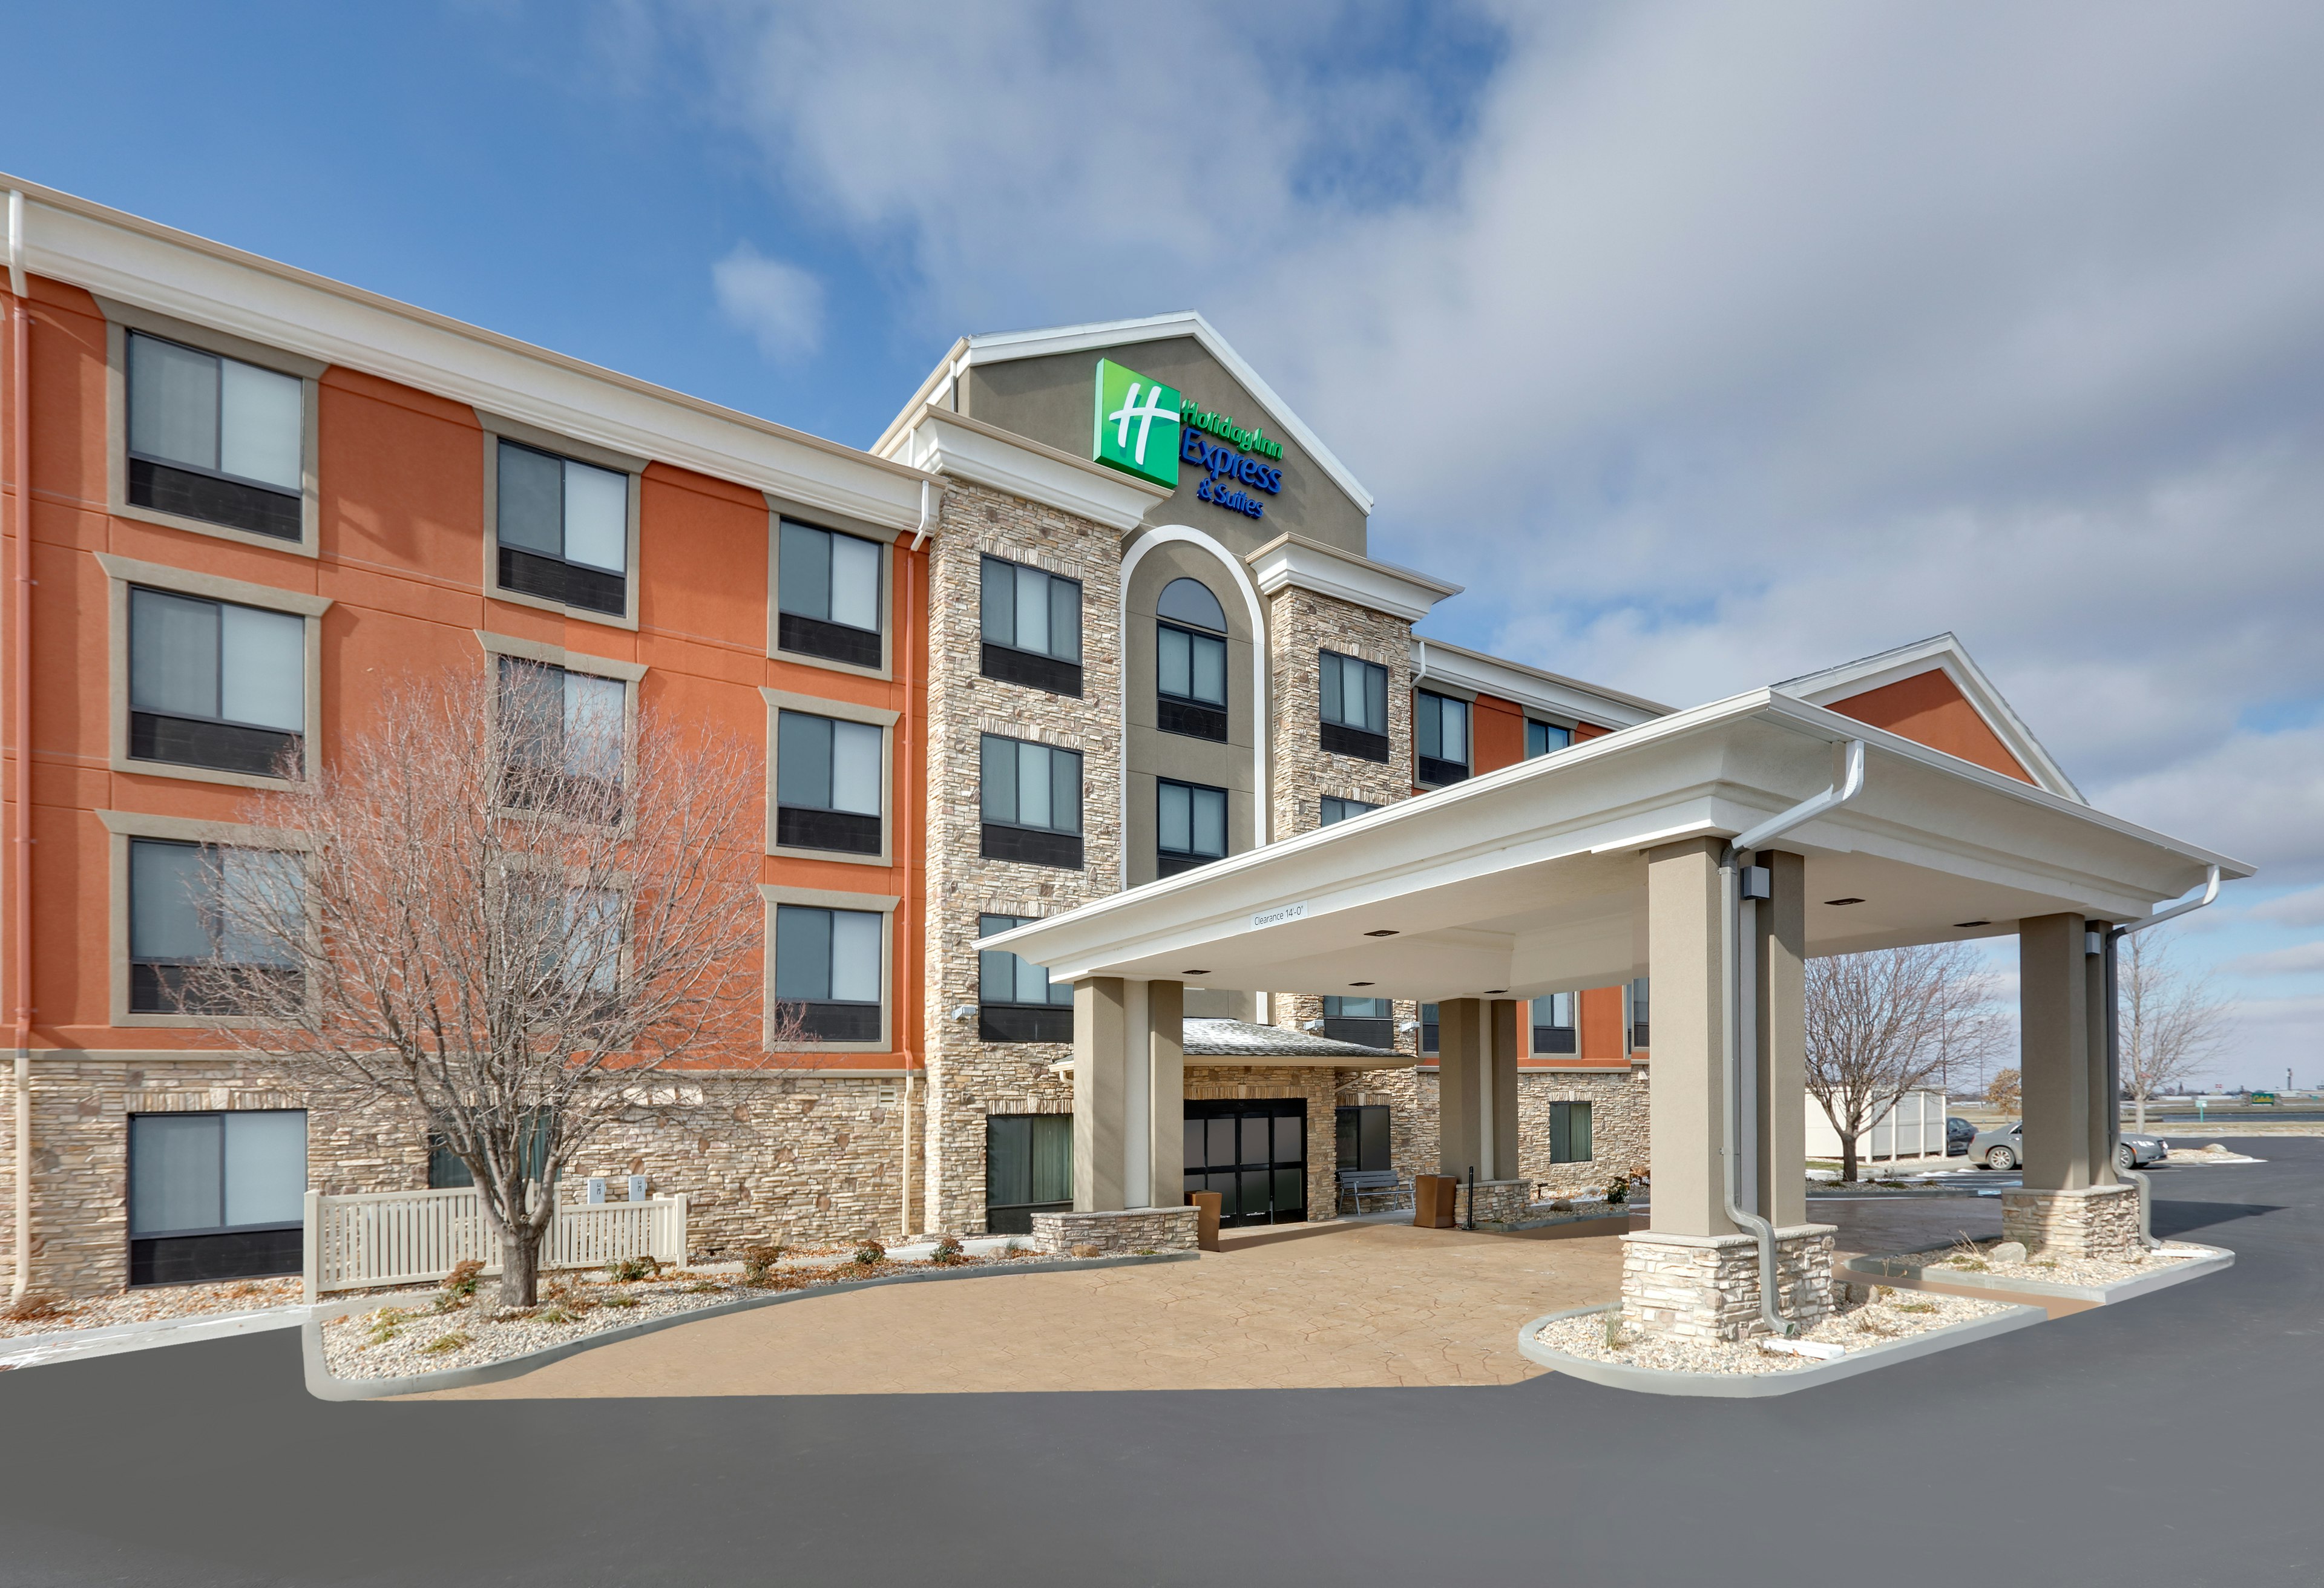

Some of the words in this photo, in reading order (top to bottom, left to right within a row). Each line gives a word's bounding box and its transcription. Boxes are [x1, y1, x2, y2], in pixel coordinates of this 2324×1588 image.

[1180, 399, 1253, 453] Holiday
[1252, 428, 1283, 462] Inn
[1180, 427, 1282, 495] Express
[1196, 477, 1212, 502] &
[1212, 484, 1264, 519] Suites
[1254, 912, 1284, 925] Clearance
